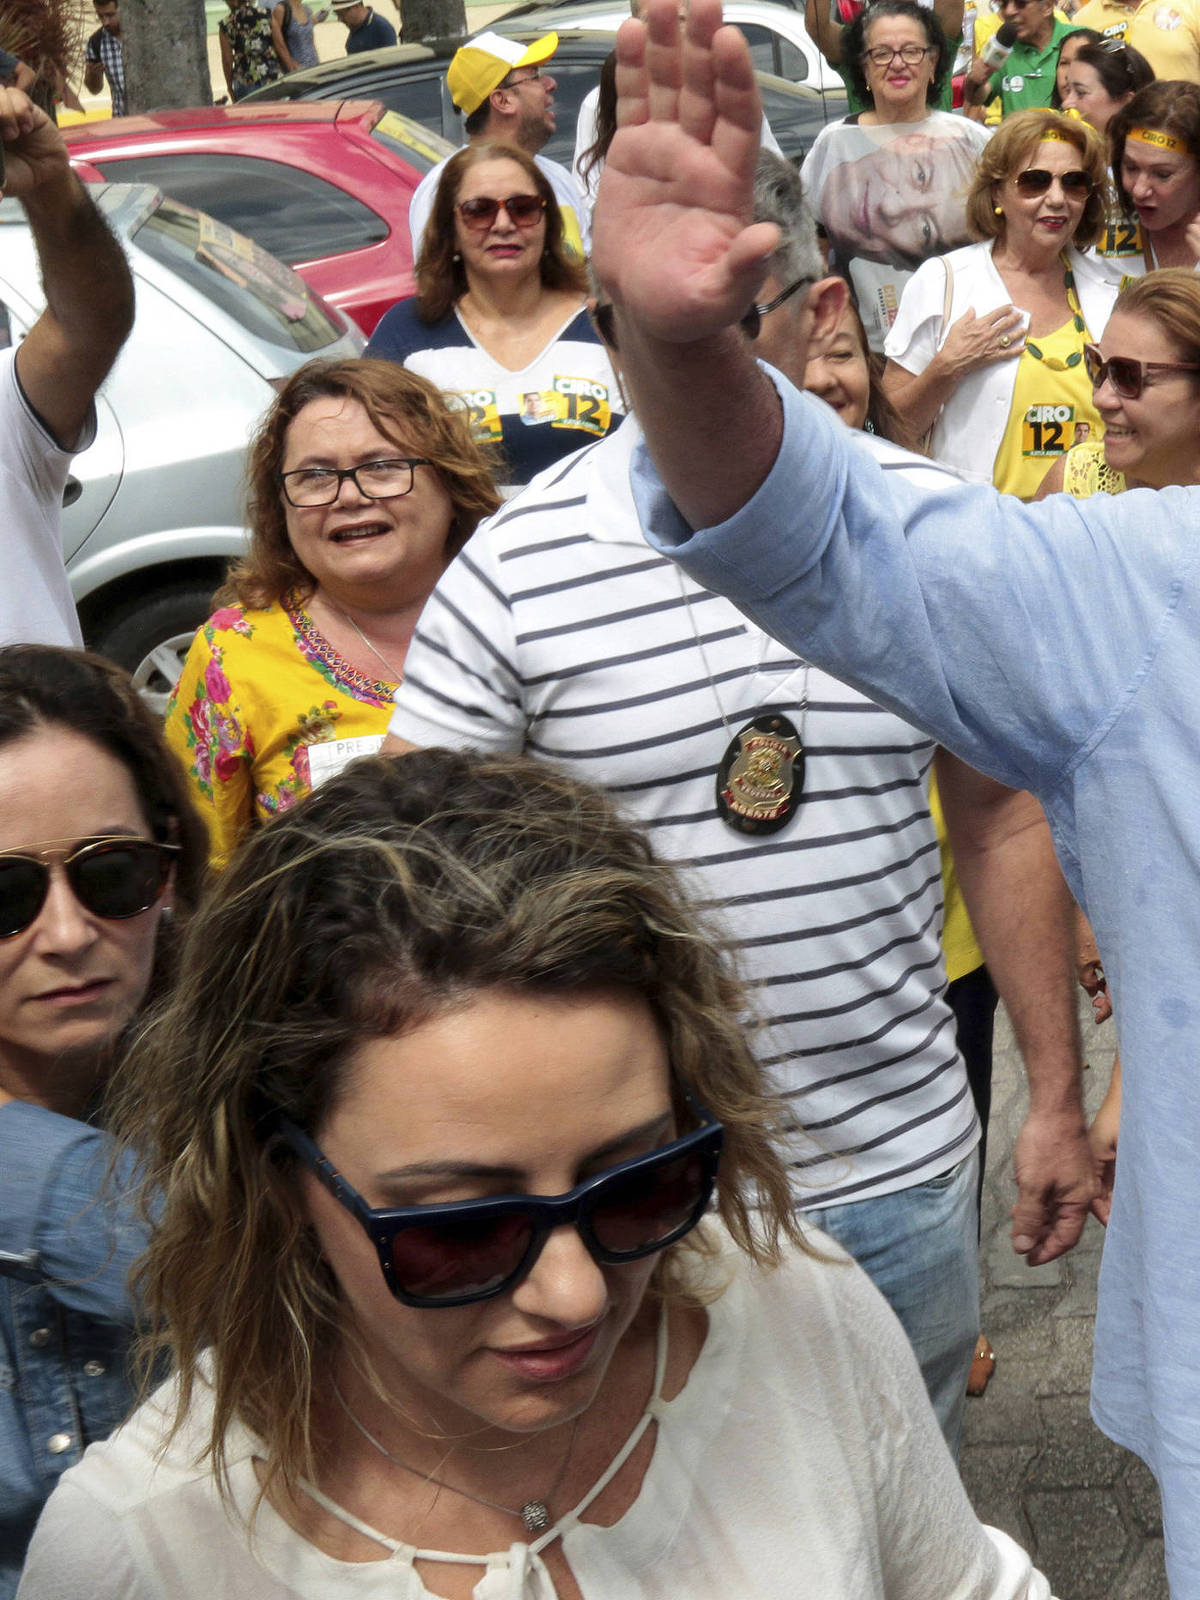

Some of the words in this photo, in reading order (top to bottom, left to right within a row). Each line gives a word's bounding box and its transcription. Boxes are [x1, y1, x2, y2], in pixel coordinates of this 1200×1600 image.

[1103, 21, 1128, 37] CIRO
[1142, 131, 1165, 145] CIRO
[1166, 137, 1177, 150] 12
[1106, 224, 1138, 252] 12
[555, 379, 607, 402] CIRO
[563, 393, 601, 426] 12
[1026, 405, 1071, 422] CIRO
[1029, 421, 1065, 451] 12
